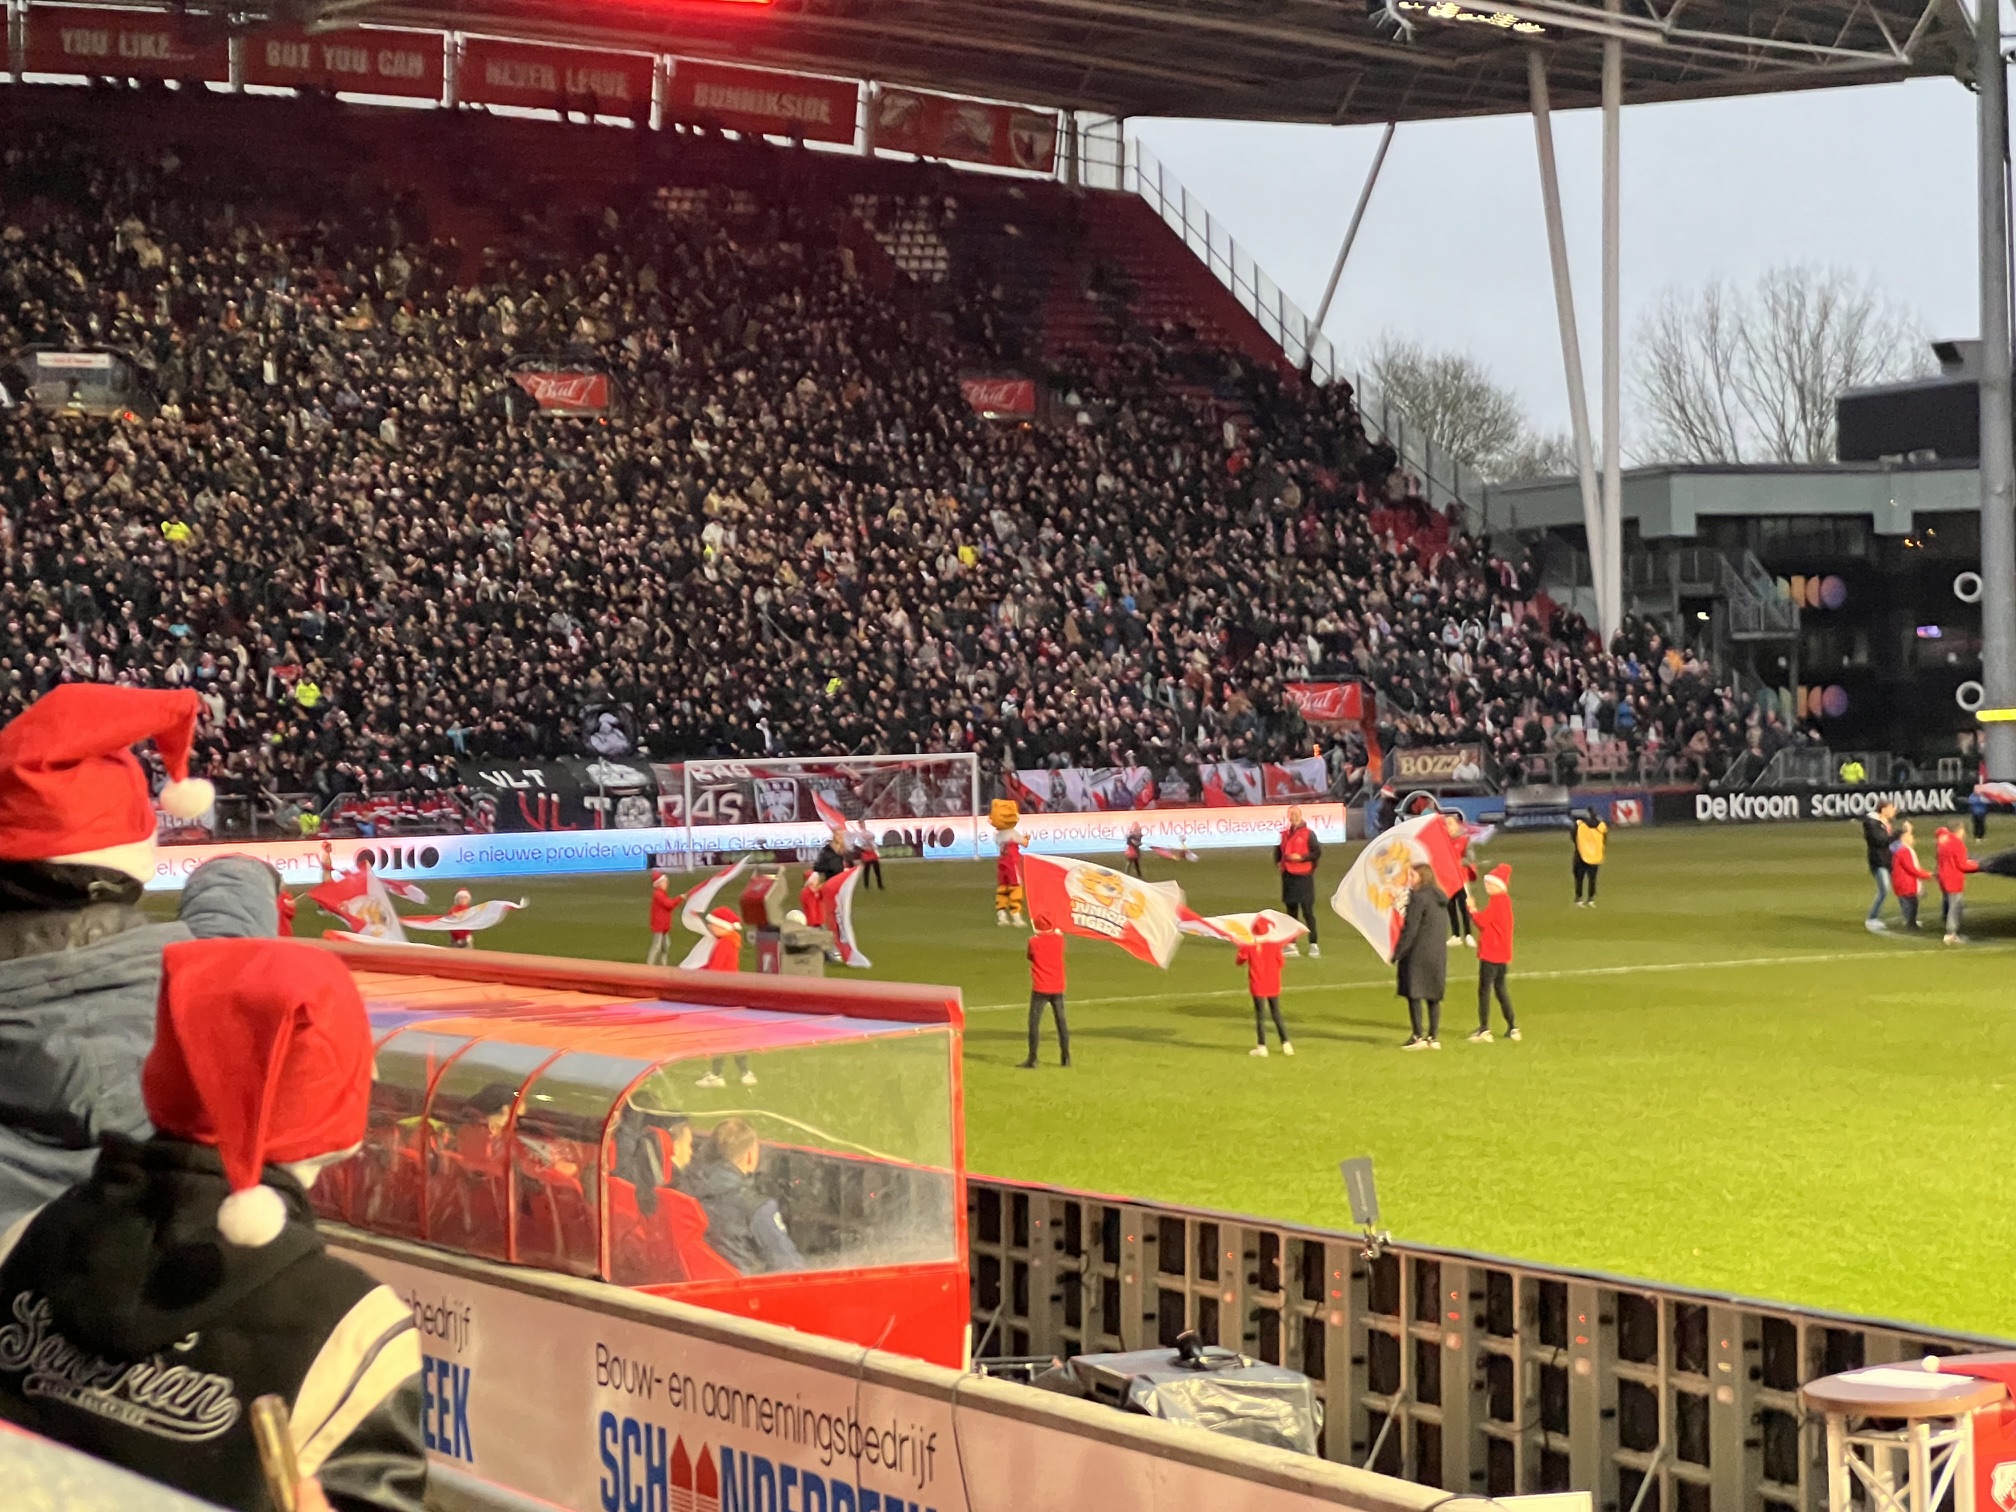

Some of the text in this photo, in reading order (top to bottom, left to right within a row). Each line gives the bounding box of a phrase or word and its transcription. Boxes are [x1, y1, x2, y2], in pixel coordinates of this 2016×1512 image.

[266, 40, 424, 78] BUT YOU CAN
[1811, 788, 1955, 817] SCHOONMAAK
[1053, 824, 1117, 843] provider
[456, 846, 475, 863] Je
[479, 845, 542, 862] nieuwe
[546, 842, 618, 863] provider
[1071, 900, 1128, 926] JUNIOR
[1071, 912, 1122, 937] TIGERS
[410, 1290, 470, 1353] bedrijf
[423, 1354, 474, 1463] EEK
[596, 1342, 663, 1400] Bouw-
[668, 1371, 698, 1414] en
[702, 1381, 937, 1490] aannemingsbedrijf
